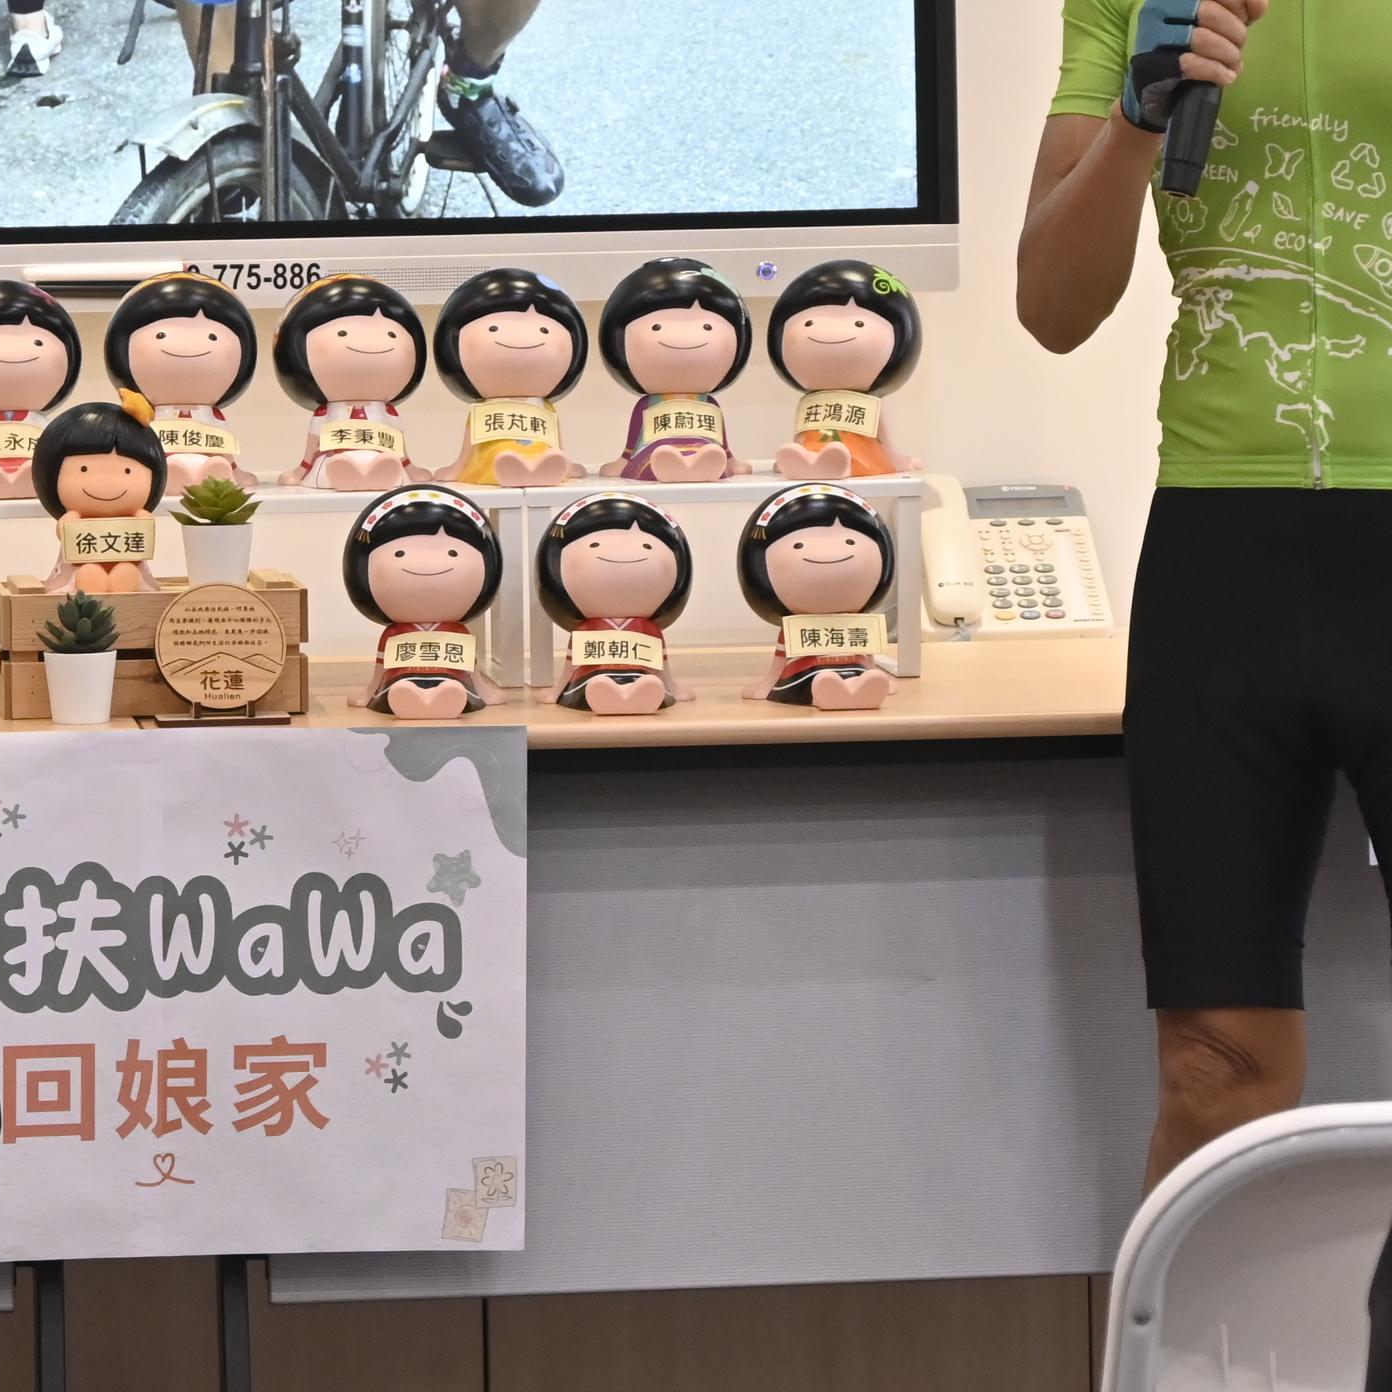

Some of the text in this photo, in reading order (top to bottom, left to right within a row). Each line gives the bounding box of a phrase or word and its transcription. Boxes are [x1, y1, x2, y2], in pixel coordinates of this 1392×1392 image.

[1250, 107, 1349, 142] friendly
[1321, 202, 1370, 230] SAVE
[484, 412, 548, 437] 張芃軒
[653, 411, 718, 434] 陳蔚理
[803, 402, 867, 426] 莊鴻源
[158, 429, 226, 450] 陳俊慶
[75, 530, 146, 556] 徐文達
[800, 627, 870, 649] 陳海壽
[395, 641, 466, 664] 廖雪恩
[583, 639, 653, 663] 鄭朝仁
[199, 670, 245, 691] 花蓮
[204, 692, 242, 701] Hualien
[1, 1034, 332, 1146] 回娘家
